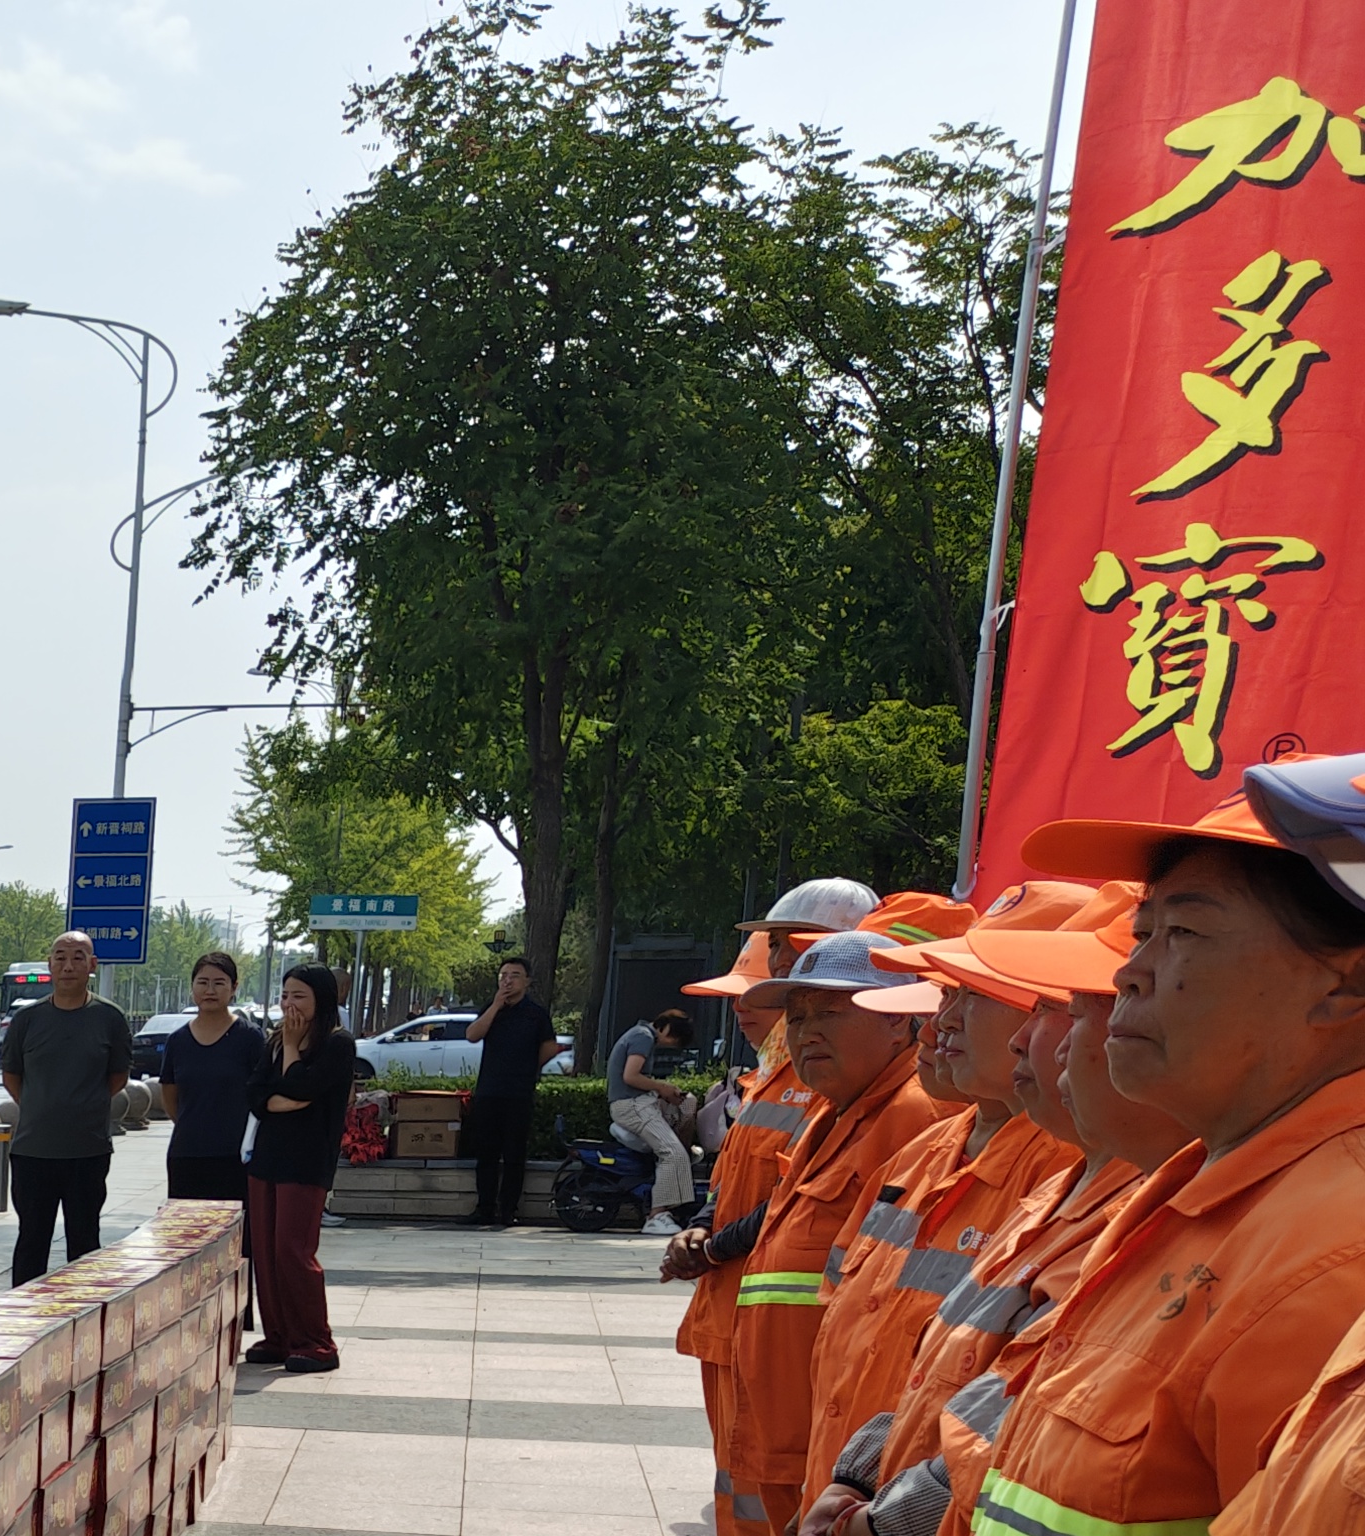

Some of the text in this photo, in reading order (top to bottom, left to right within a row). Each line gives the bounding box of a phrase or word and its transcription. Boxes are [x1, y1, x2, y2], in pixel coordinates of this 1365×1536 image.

[95, 821, 145, 836] 新晋祠路
[93, 874, 142, 888] 景福北路
[331, 898, 395, 913] 景福南路
